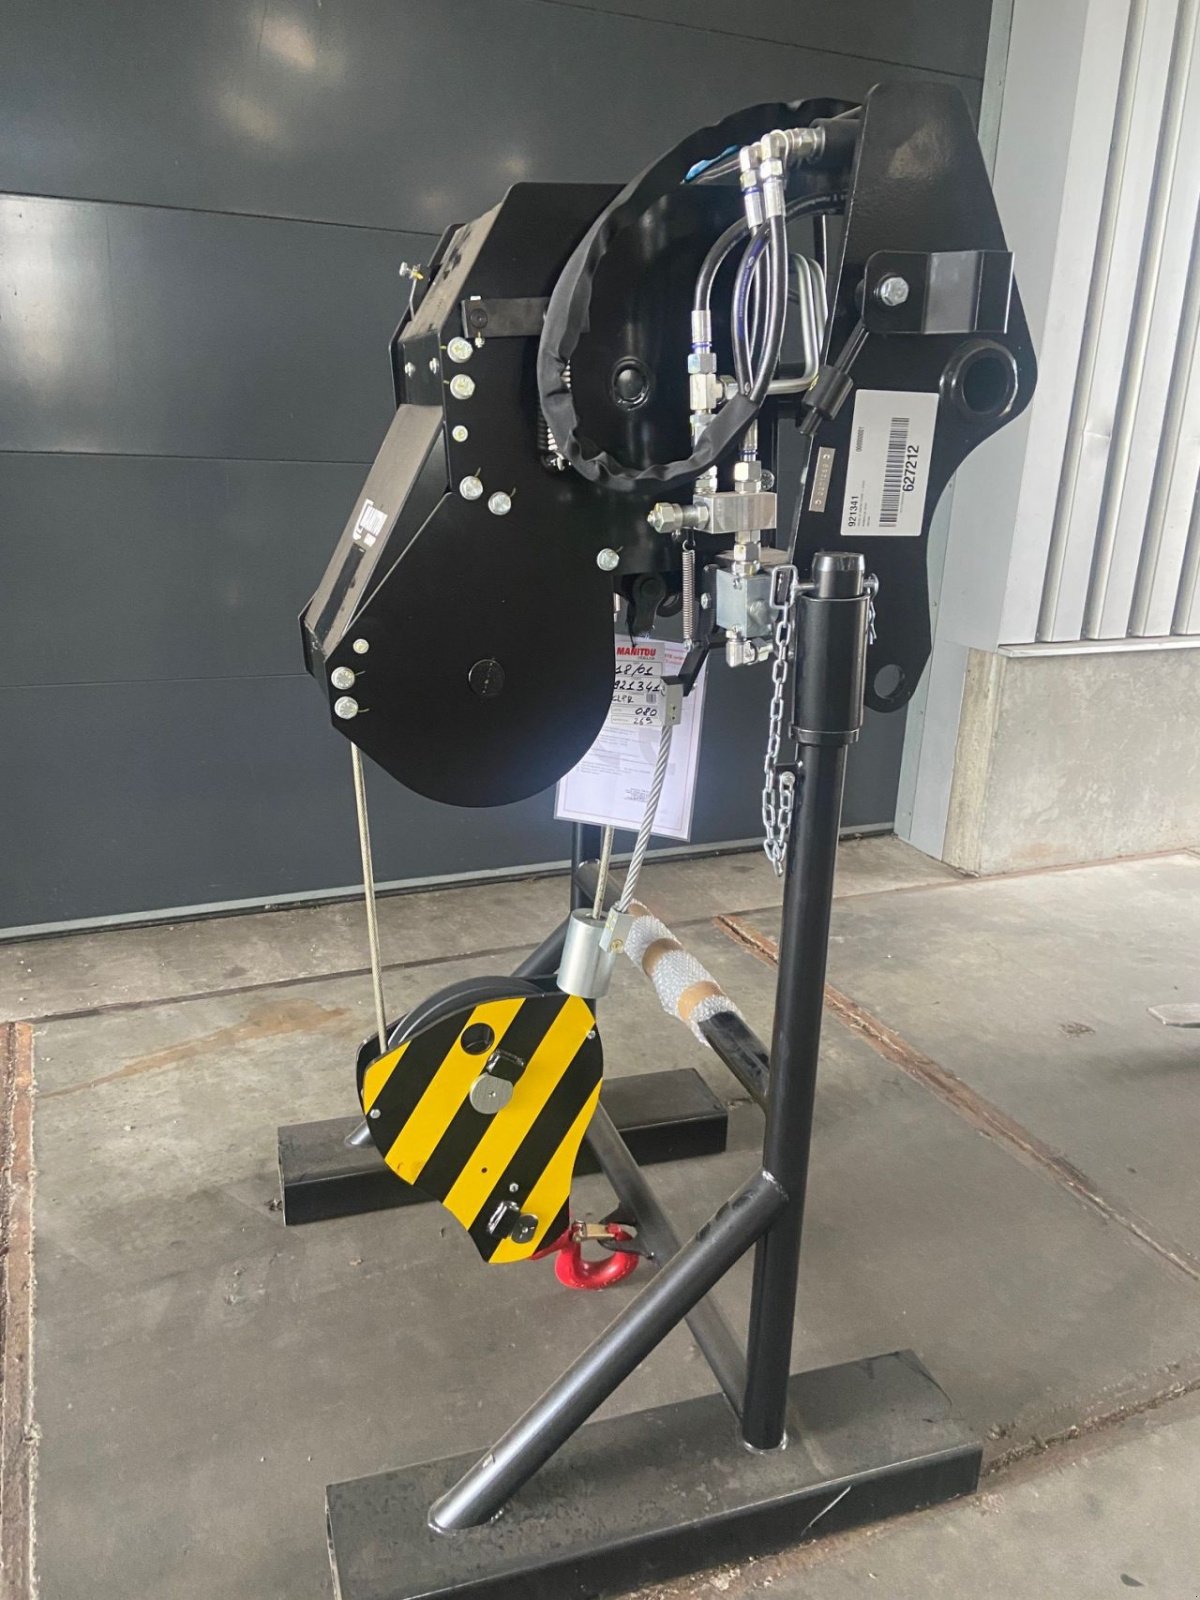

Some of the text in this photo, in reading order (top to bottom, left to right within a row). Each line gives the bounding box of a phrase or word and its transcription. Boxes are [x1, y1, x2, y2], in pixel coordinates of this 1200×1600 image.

[903, 445, 919, 491] 627212
[848, 496, 859, 527] 921341
[616, 647, 656, 656] MANITOU
[635, 707, 657, 717] 080
